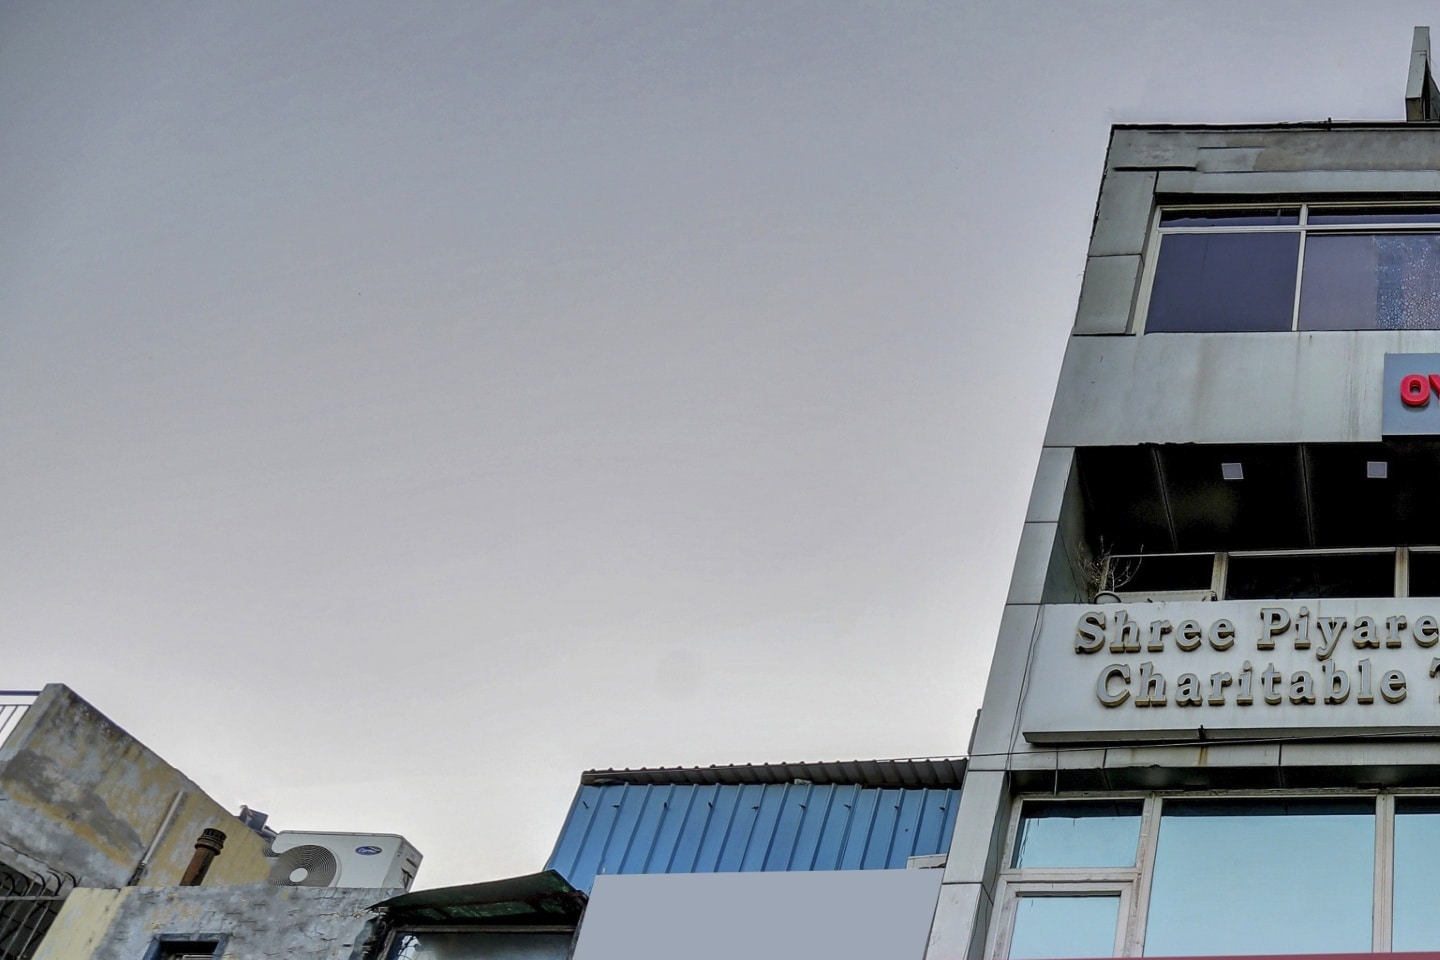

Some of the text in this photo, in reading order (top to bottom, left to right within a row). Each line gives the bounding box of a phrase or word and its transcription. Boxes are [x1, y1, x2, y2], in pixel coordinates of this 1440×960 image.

[1075, 610, 1236, 654] Shree
[1256, 605, 1440, 661] Piyare
[1095, 658, 1408, 708] Charitable
